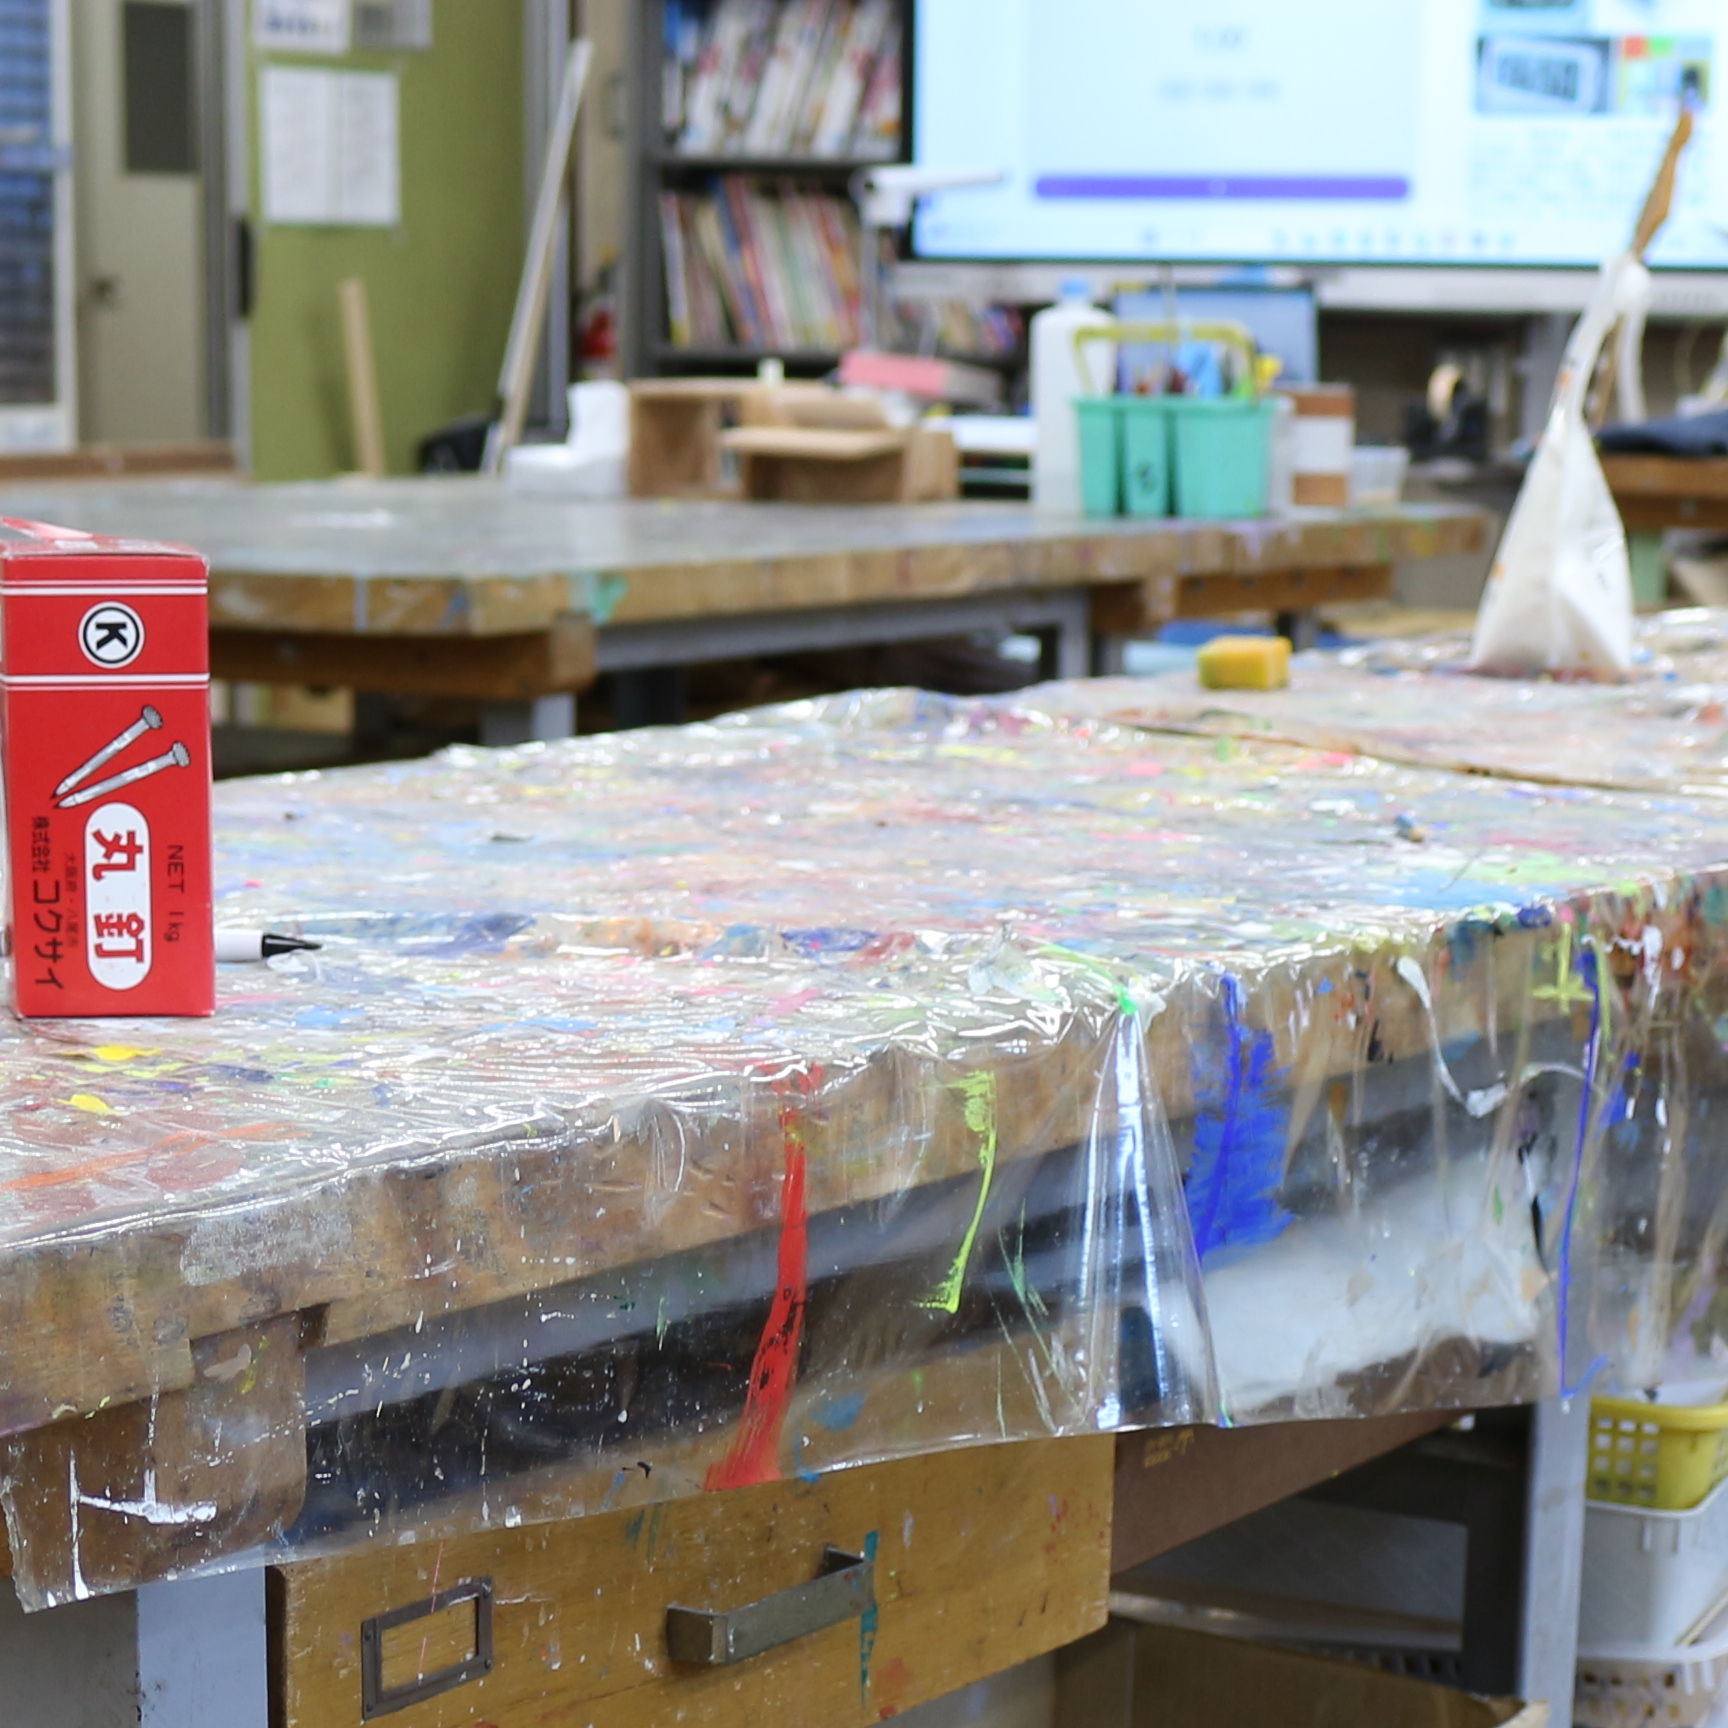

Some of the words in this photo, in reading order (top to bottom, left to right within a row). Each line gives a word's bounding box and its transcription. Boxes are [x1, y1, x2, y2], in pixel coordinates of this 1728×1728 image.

[95, 621, 129, 651] K
[167, 844, 185, 894] NET
[92, 828, 145, 964] 丸釘
